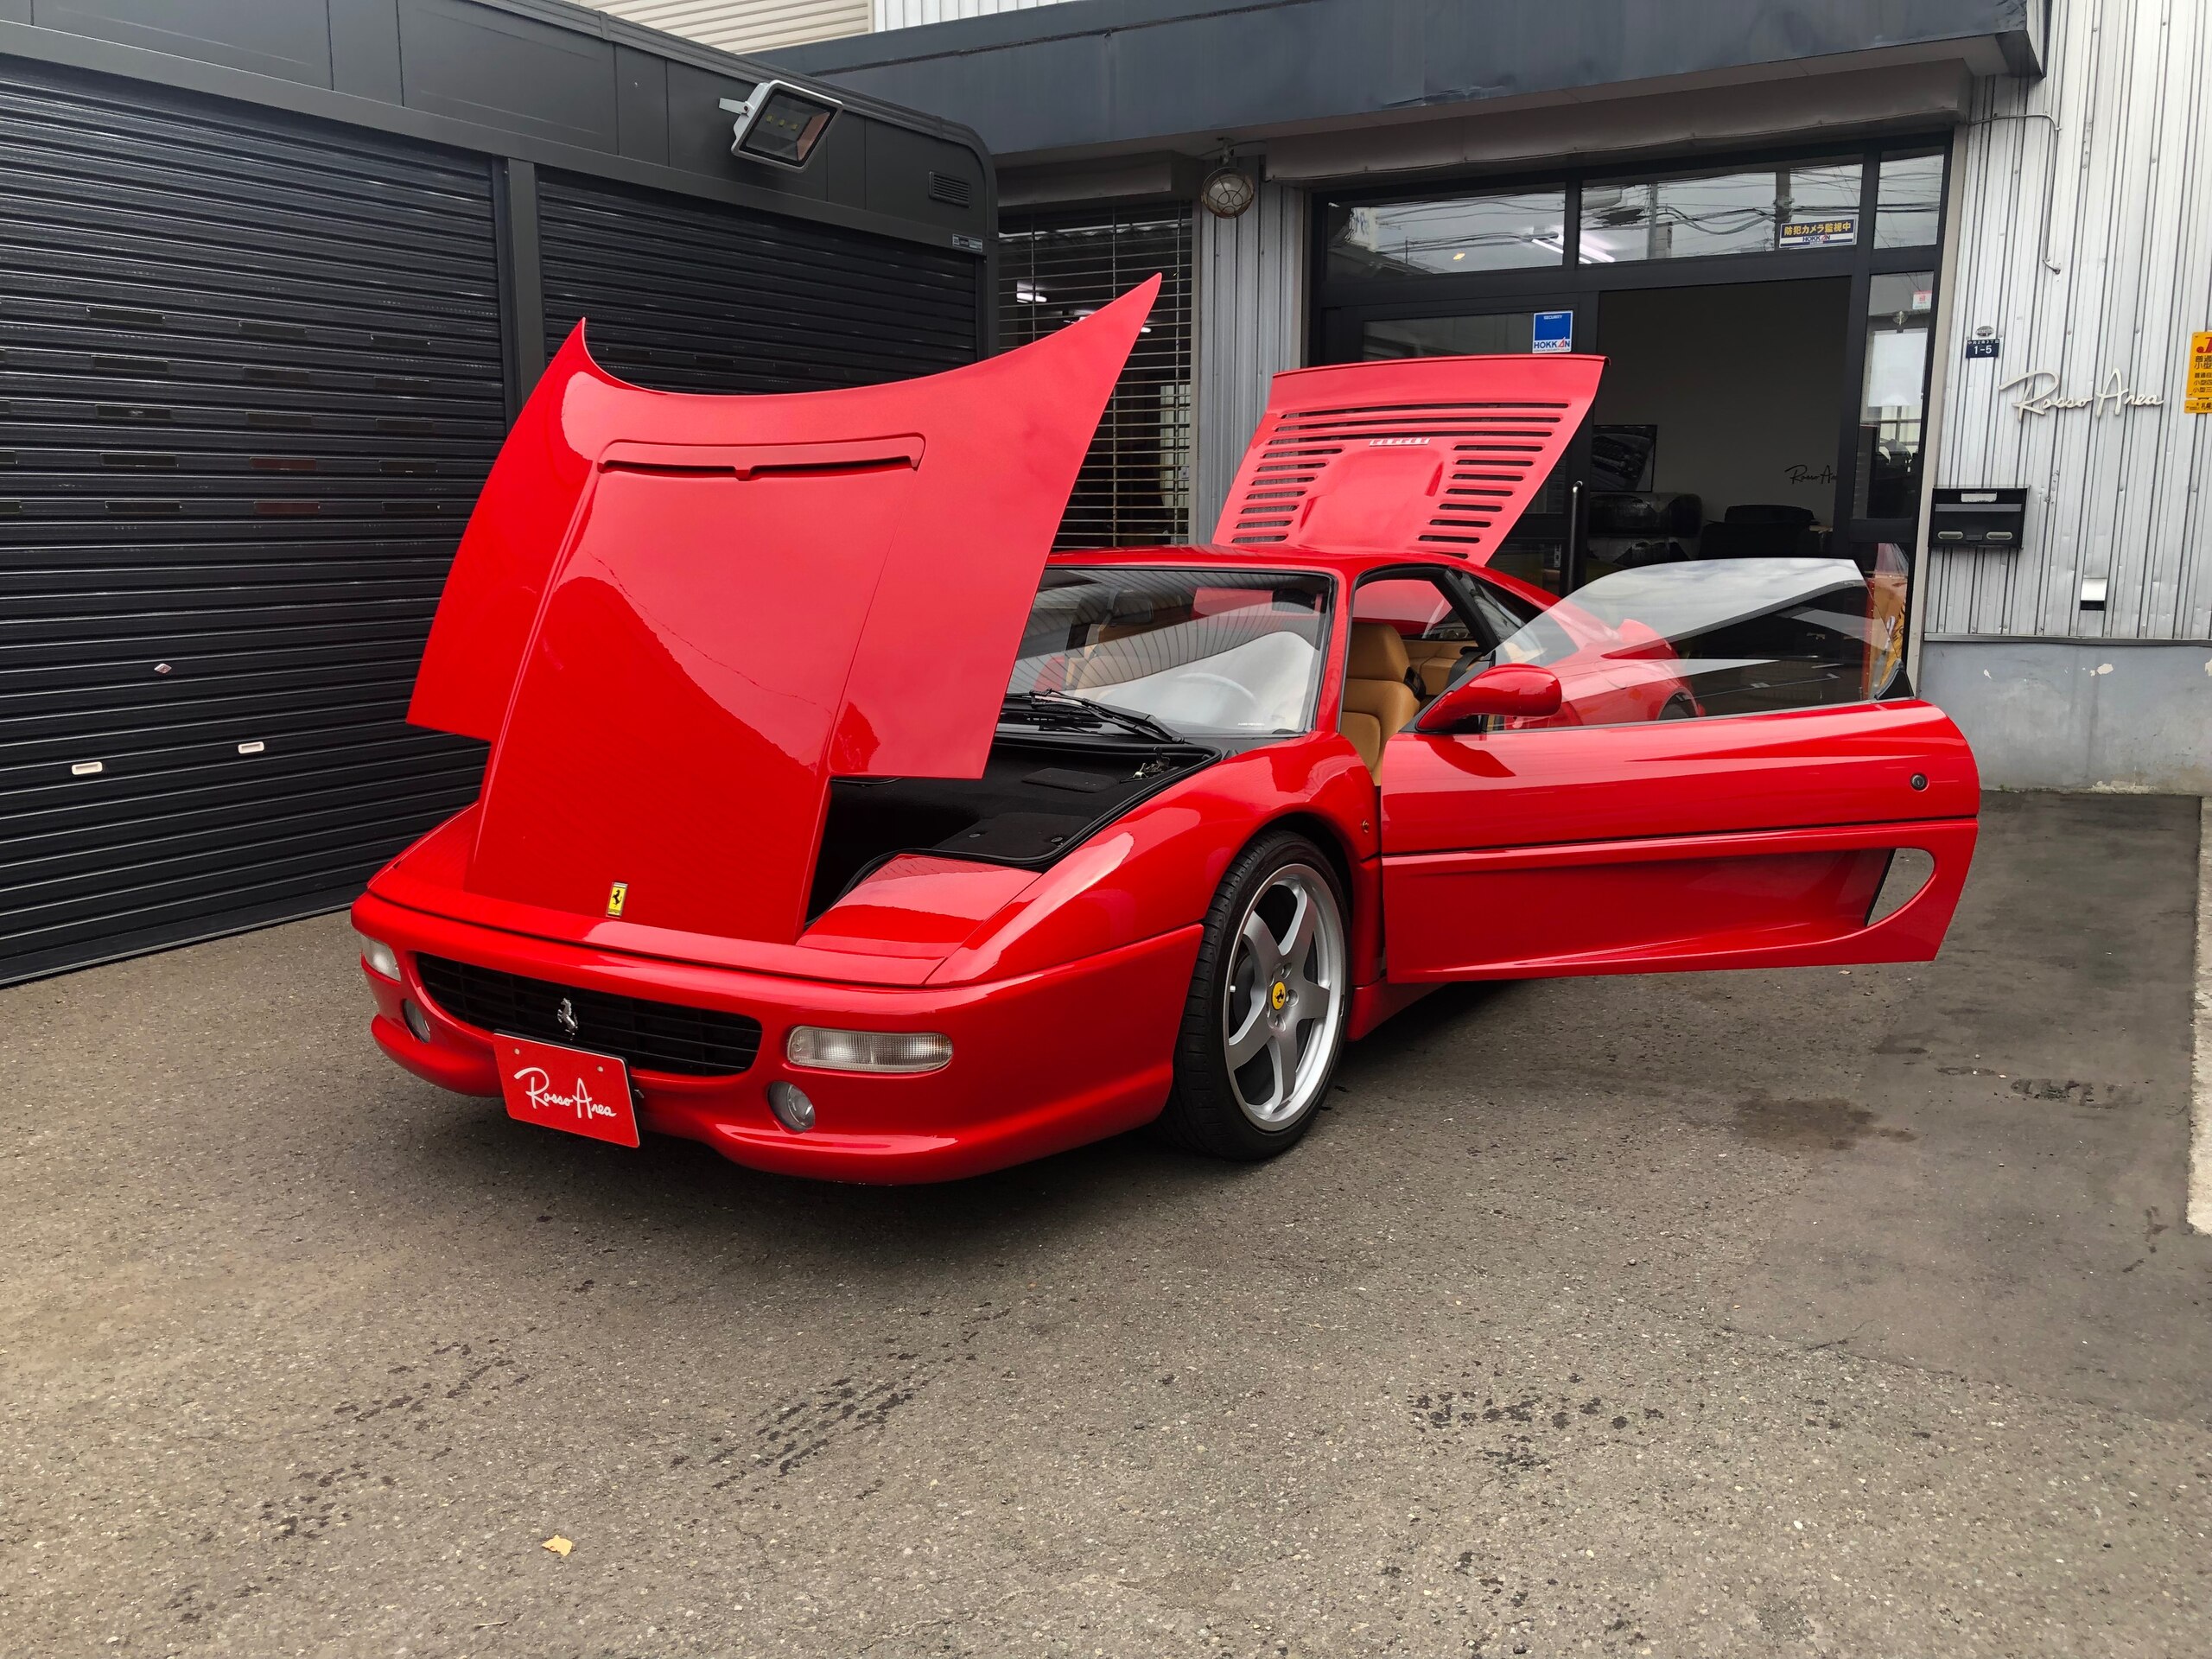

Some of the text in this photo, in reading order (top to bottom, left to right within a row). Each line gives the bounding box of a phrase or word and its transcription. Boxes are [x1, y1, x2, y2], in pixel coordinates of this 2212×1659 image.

[1783, 221, 1852, 236] 防犯カメラ監視中
[1534, 337, 1570, 348] HOKKAN
[1974, 345, 1993, 355] 1-5
[1998, 368, 2164, 422] Rosso Area
[513, 1067, 617, 1120] Rosso Area
